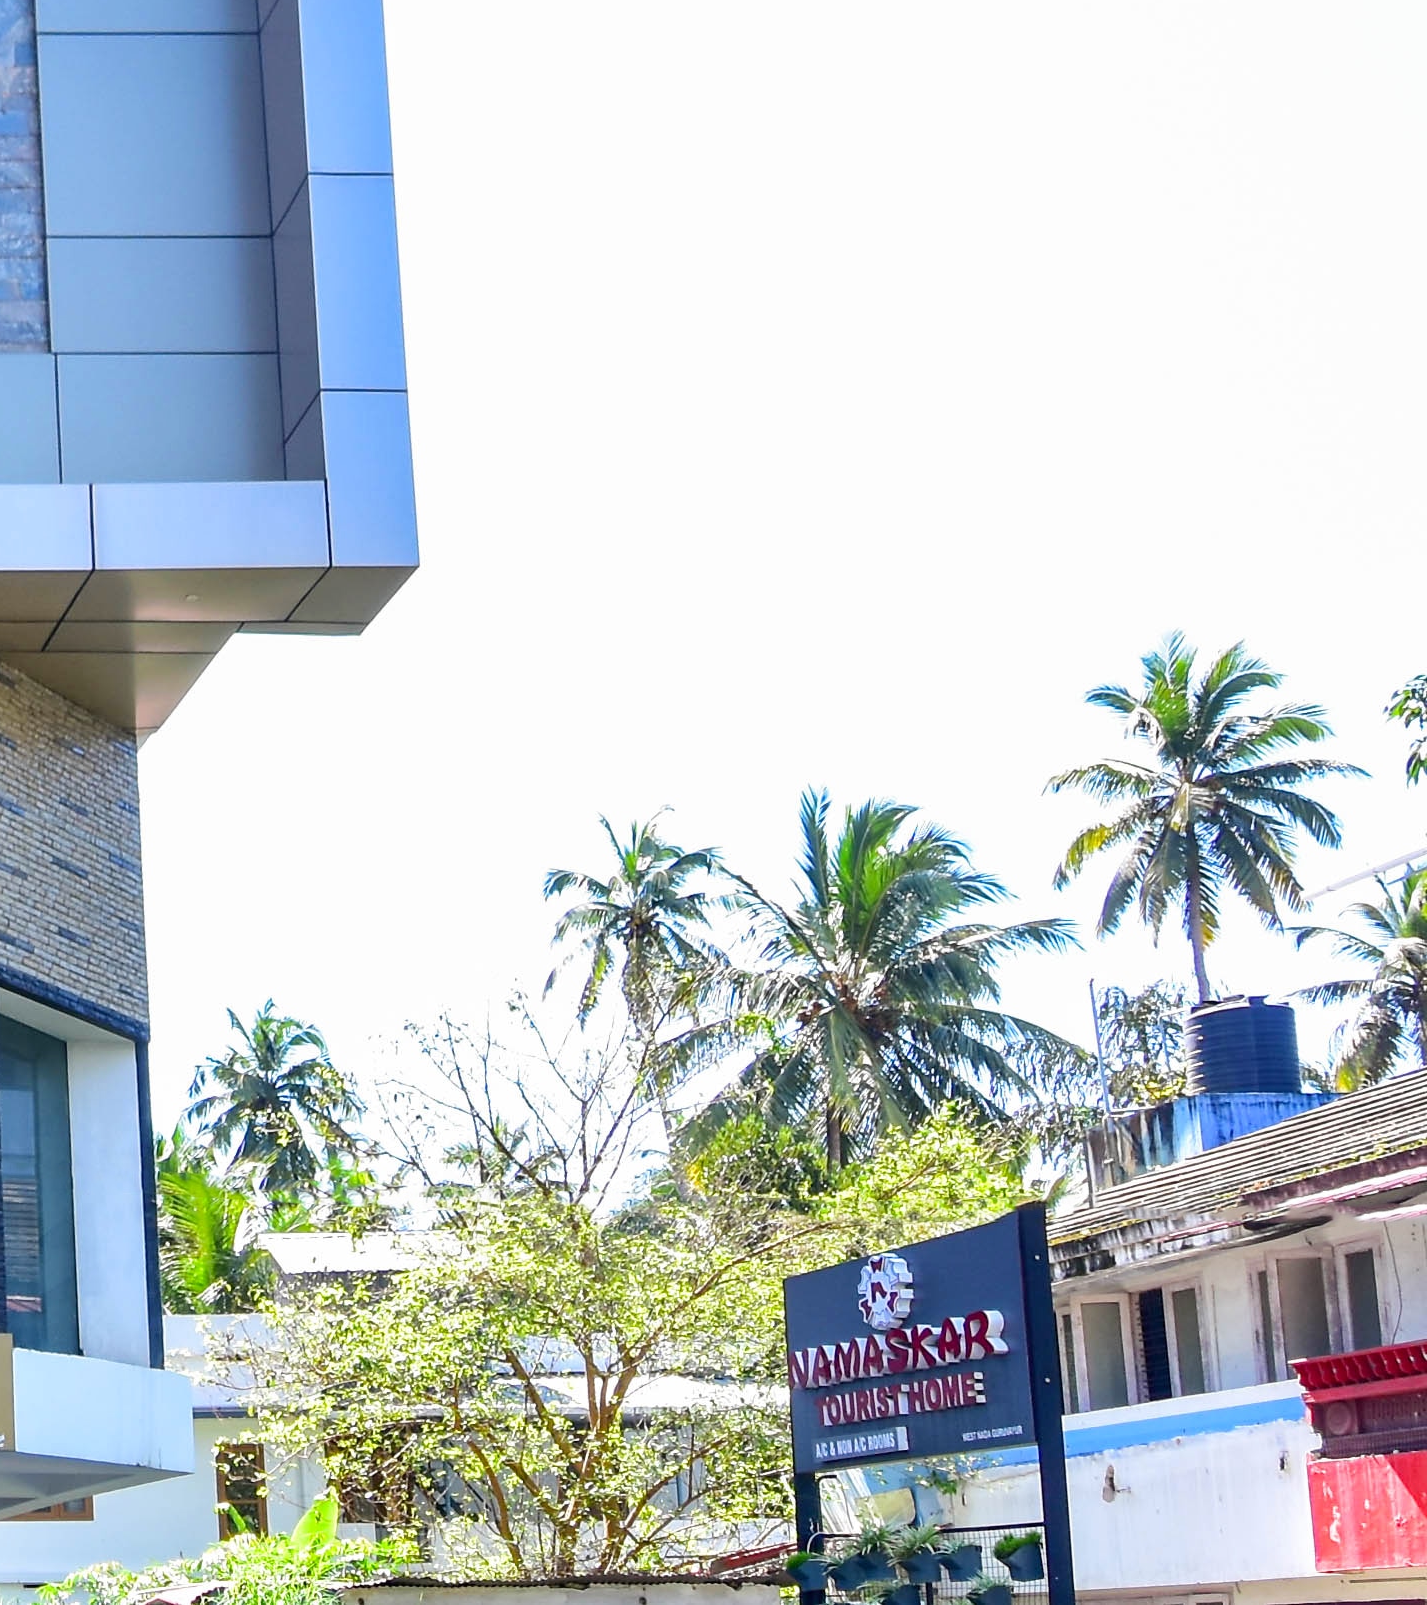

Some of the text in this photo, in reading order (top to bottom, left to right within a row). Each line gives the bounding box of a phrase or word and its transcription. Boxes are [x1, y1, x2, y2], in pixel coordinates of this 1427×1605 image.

[789, 1311, 1003, 1388] NAMASKAR
[815, 1372, 981, 1427] TOURIST HOME
[867, 1432, 895, 1451] ROOMS
